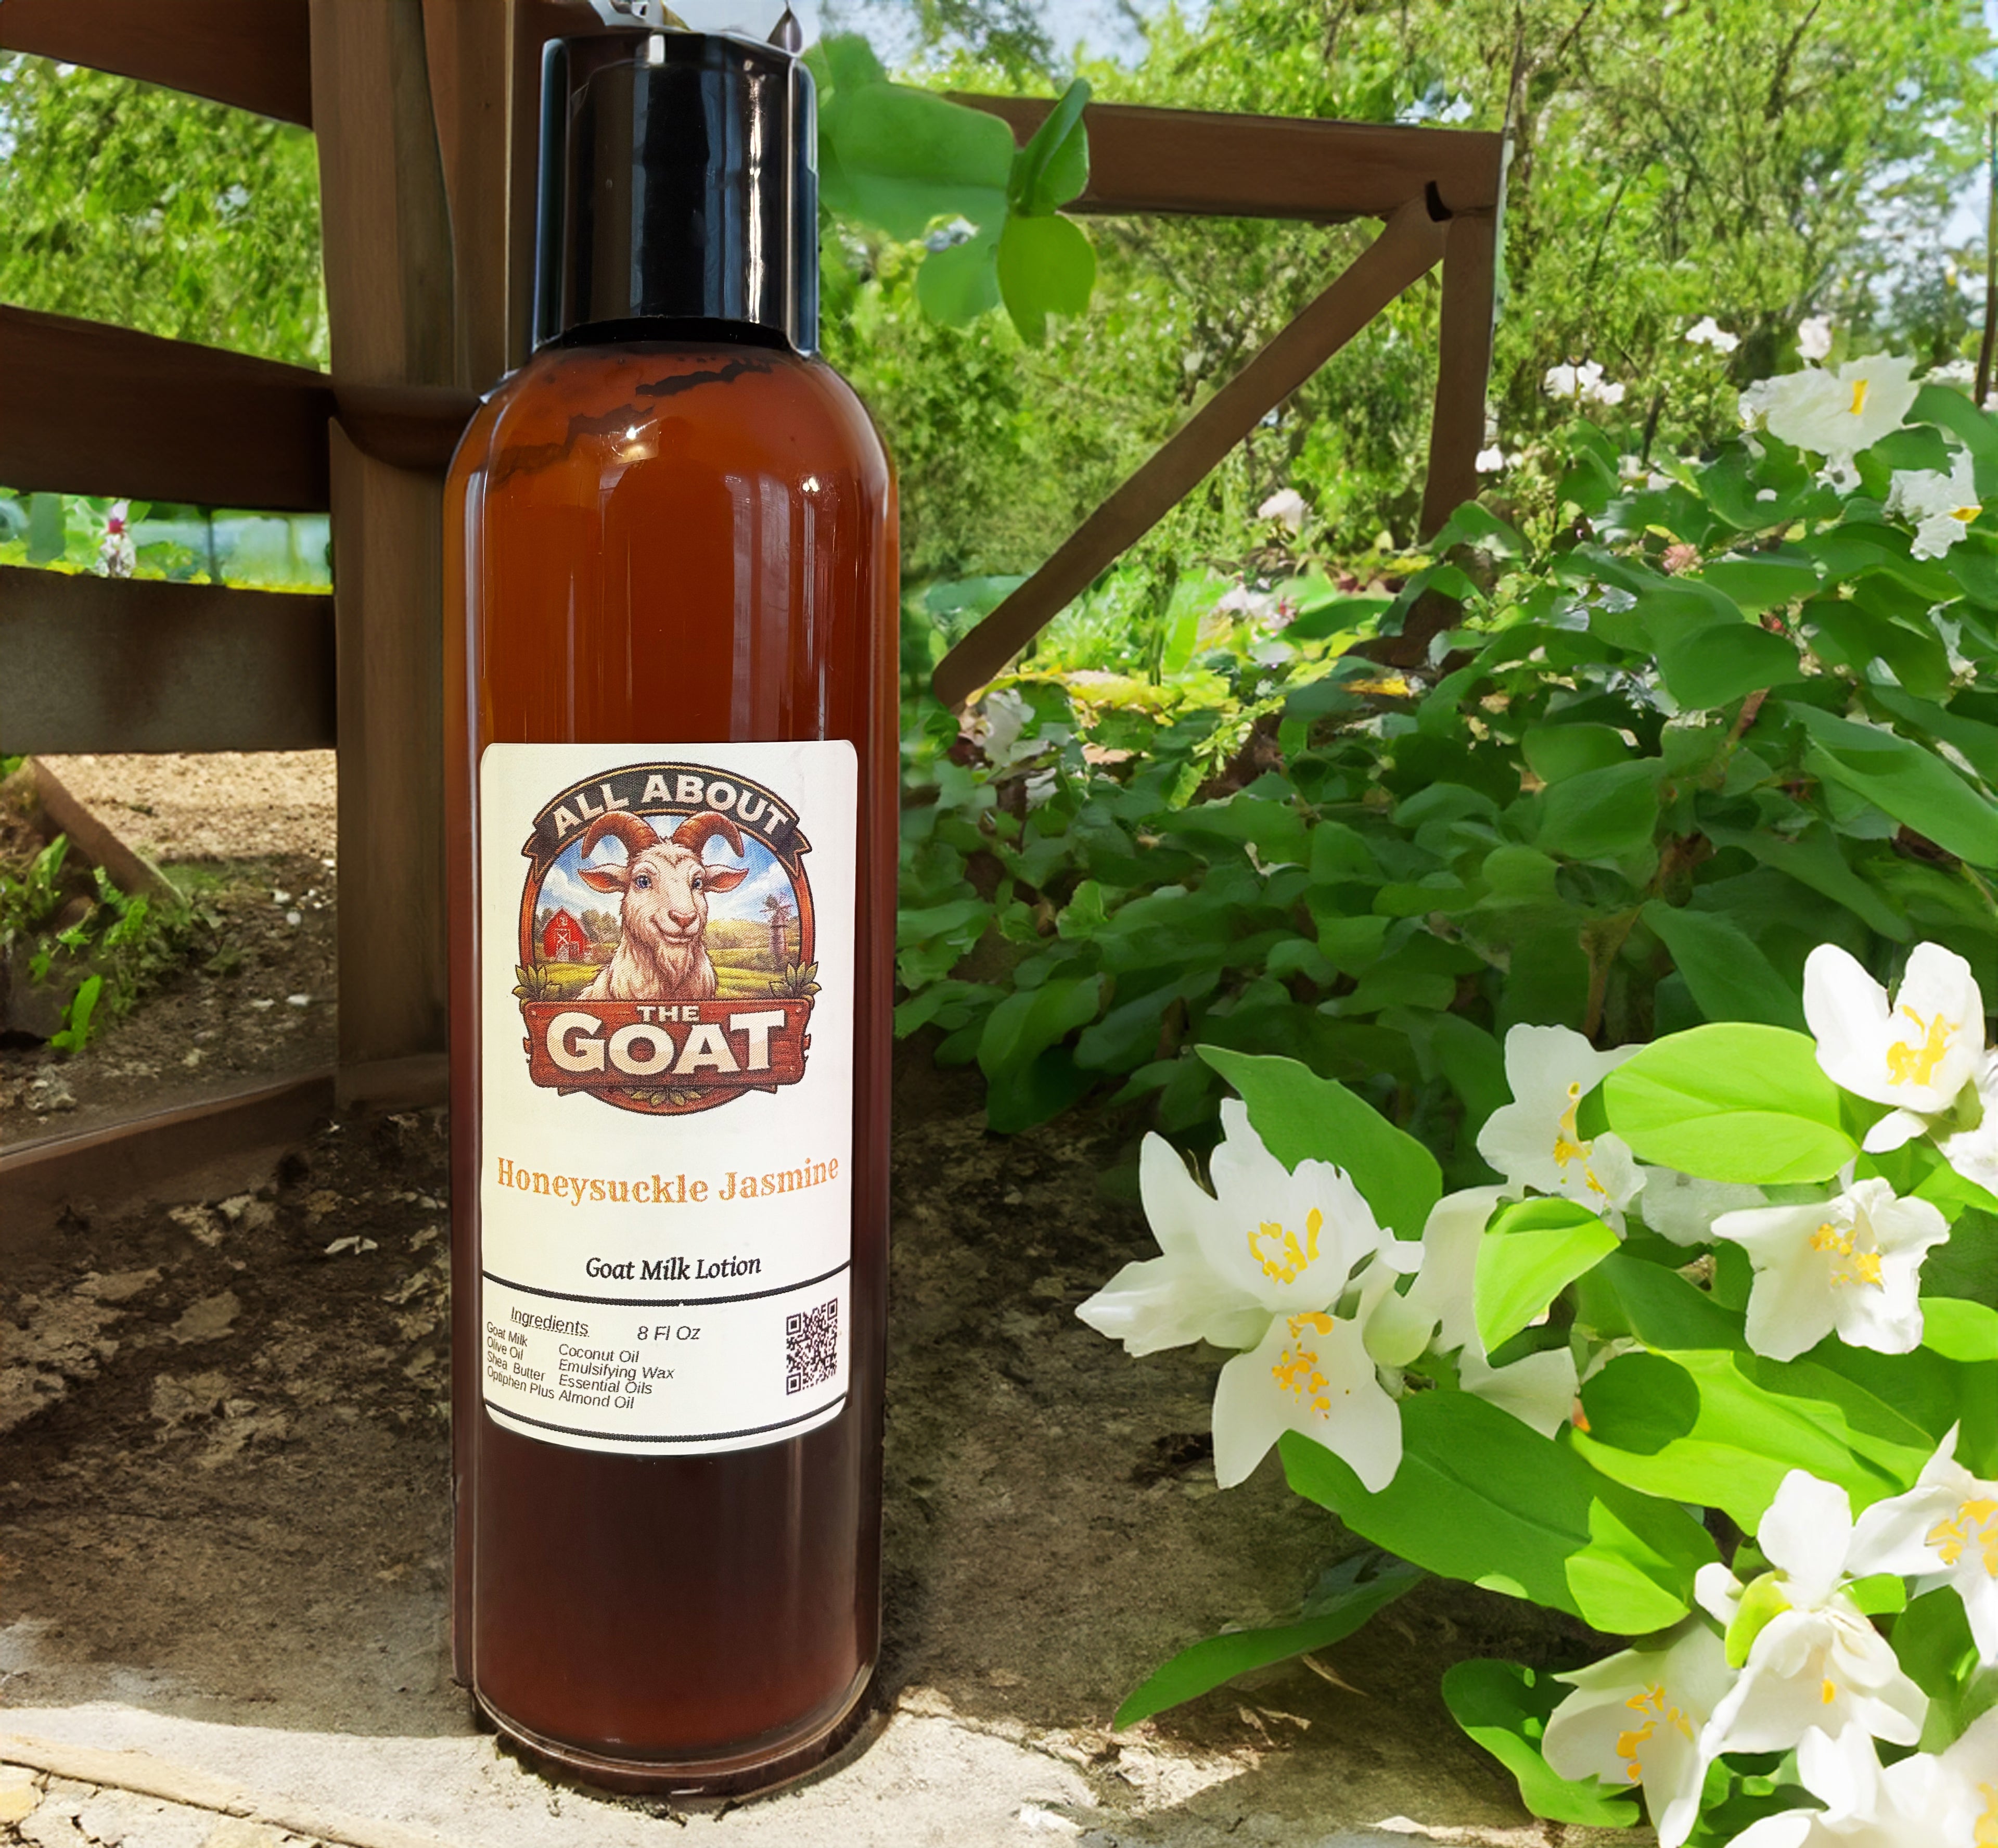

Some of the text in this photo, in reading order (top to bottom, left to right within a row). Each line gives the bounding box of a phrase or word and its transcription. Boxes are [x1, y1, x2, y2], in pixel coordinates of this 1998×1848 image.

[553, 773, 789, 839] ALL ABOUT
[637, 1005, 699, 1022] THE
[547, 1010, 785, 1075] GOAT
[497, 1156, 839, 1206] Honeysuckle Jasmine
[586, 1255, 762, 1281] Goat Milk Lotion
[486, 1321, 528, 1347] Goat Milk
[510, 1306, 590, 1337] Ingredients
[637, 1325, 700, 1341] 8 Fl Oz
[486, 1336, 524, 1360] Olive Oil
[558, 1344, 639, 1363] Coconut Oil
[486, 1351, 546, 1382] Shea Butter
[558, 1359, 675, 1381] Emulsifying Wax
[486, 1365, 555, 1400] Optiphen Plus
[559, 1374, 653, 1395] Essential Oils
[558, 1390, 634, 1409] Almond Oil
